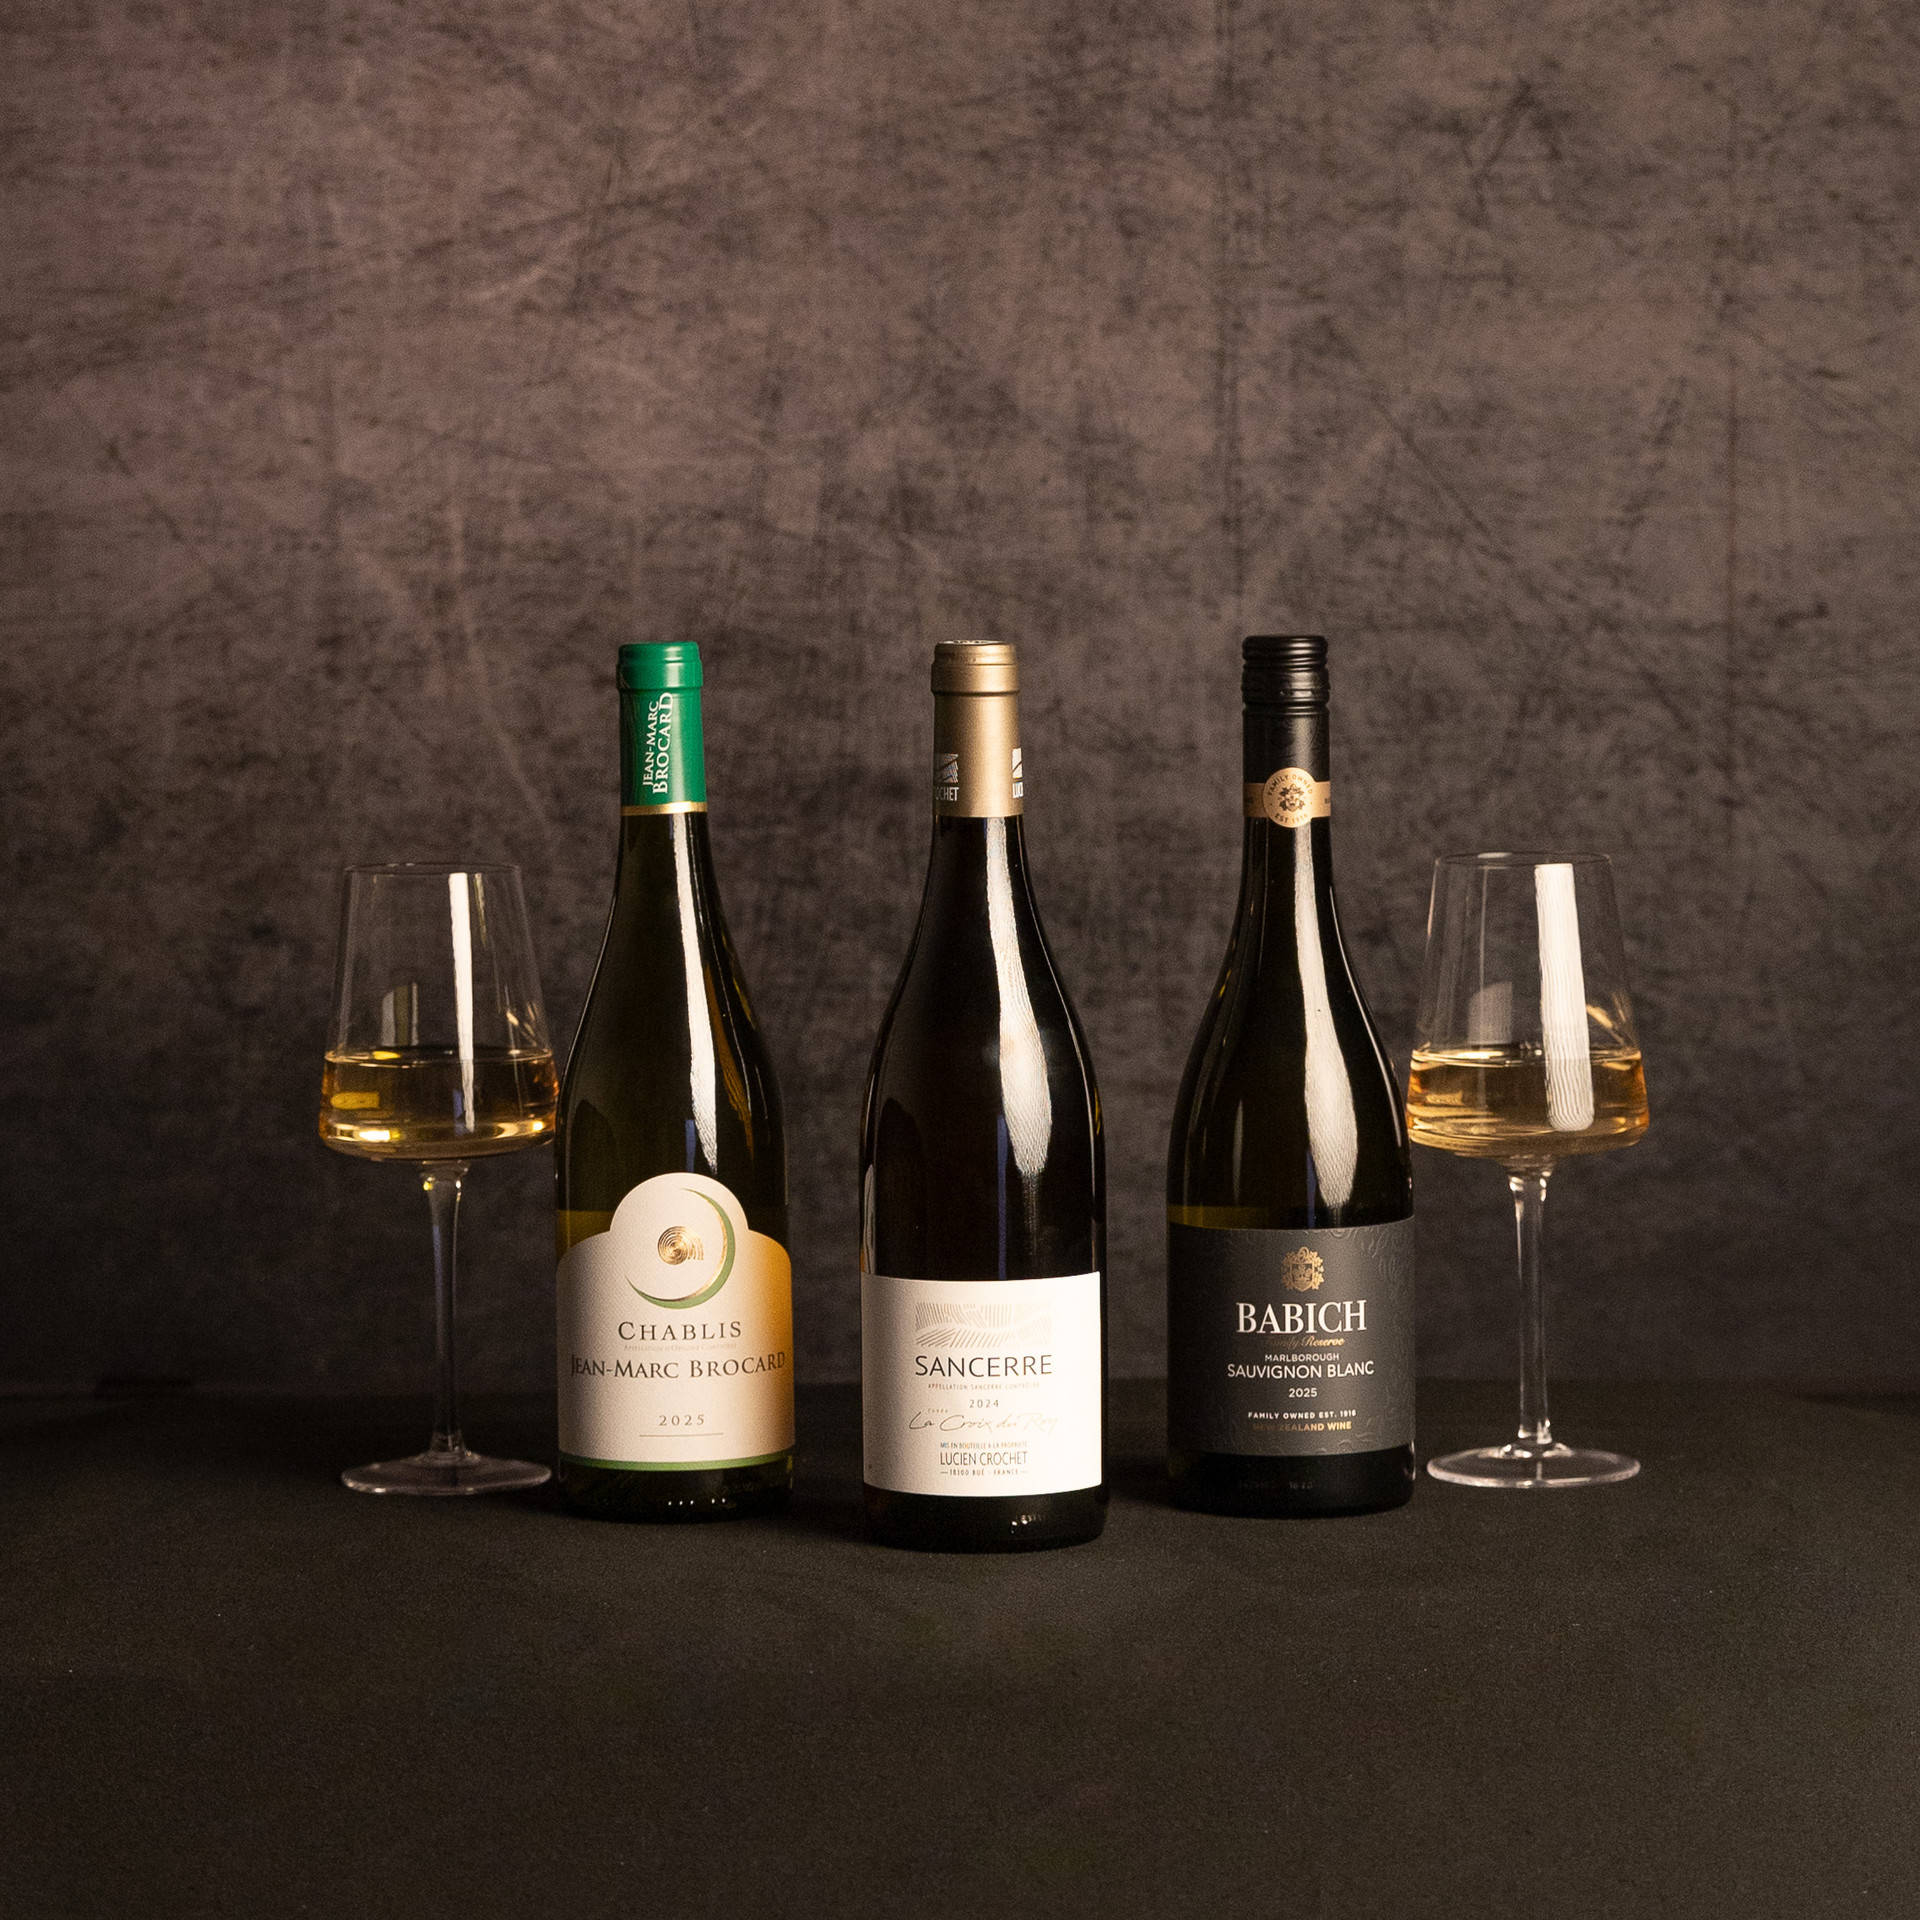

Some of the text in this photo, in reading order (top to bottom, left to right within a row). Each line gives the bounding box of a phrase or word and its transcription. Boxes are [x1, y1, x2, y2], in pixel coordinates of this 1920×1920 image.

[642, 700, 659, 786] JEAN-MARC
[652, 692, 674, 794] BROCARD
[1268, 774, 1289, 796] FAMILY
[1292, 774, 1313, 794] OWNED
[1274, 813, 1288, 823] EST
[1236, 1300, 1367, 1333] BABICH
[618, 1321, 741, 1341] CHABLIS
[1301, 1336, 1345, 1347] Reserve
[570, 1351, 786, 1379] JEAN-MARC BROCARD
[1264, 1353, 1340, 1362] MARLBOROUGH
[915, 1354, 1053, 1378] SANCERRE
[1227, 1361, 1374, 1379] SAUVIGNON BLANC
[928, 1383, 968, 1391] APPELLATION
[1288, 1387, 1318, 1398] 2025
[969, 1399, 999, 1409] 2024
[659, 1414, 705, 1427] 2025
[908, 1411, 935, 1430] La
[939, 1414, 993, 1434] Croix
[1248, 1409, 1357, 1420] FAMILY OWNED EST. 1916
[1326, 1421, 1353, 1431] WINE
[940, 1451, 1028, 1466] LUCIEN CROCHET
